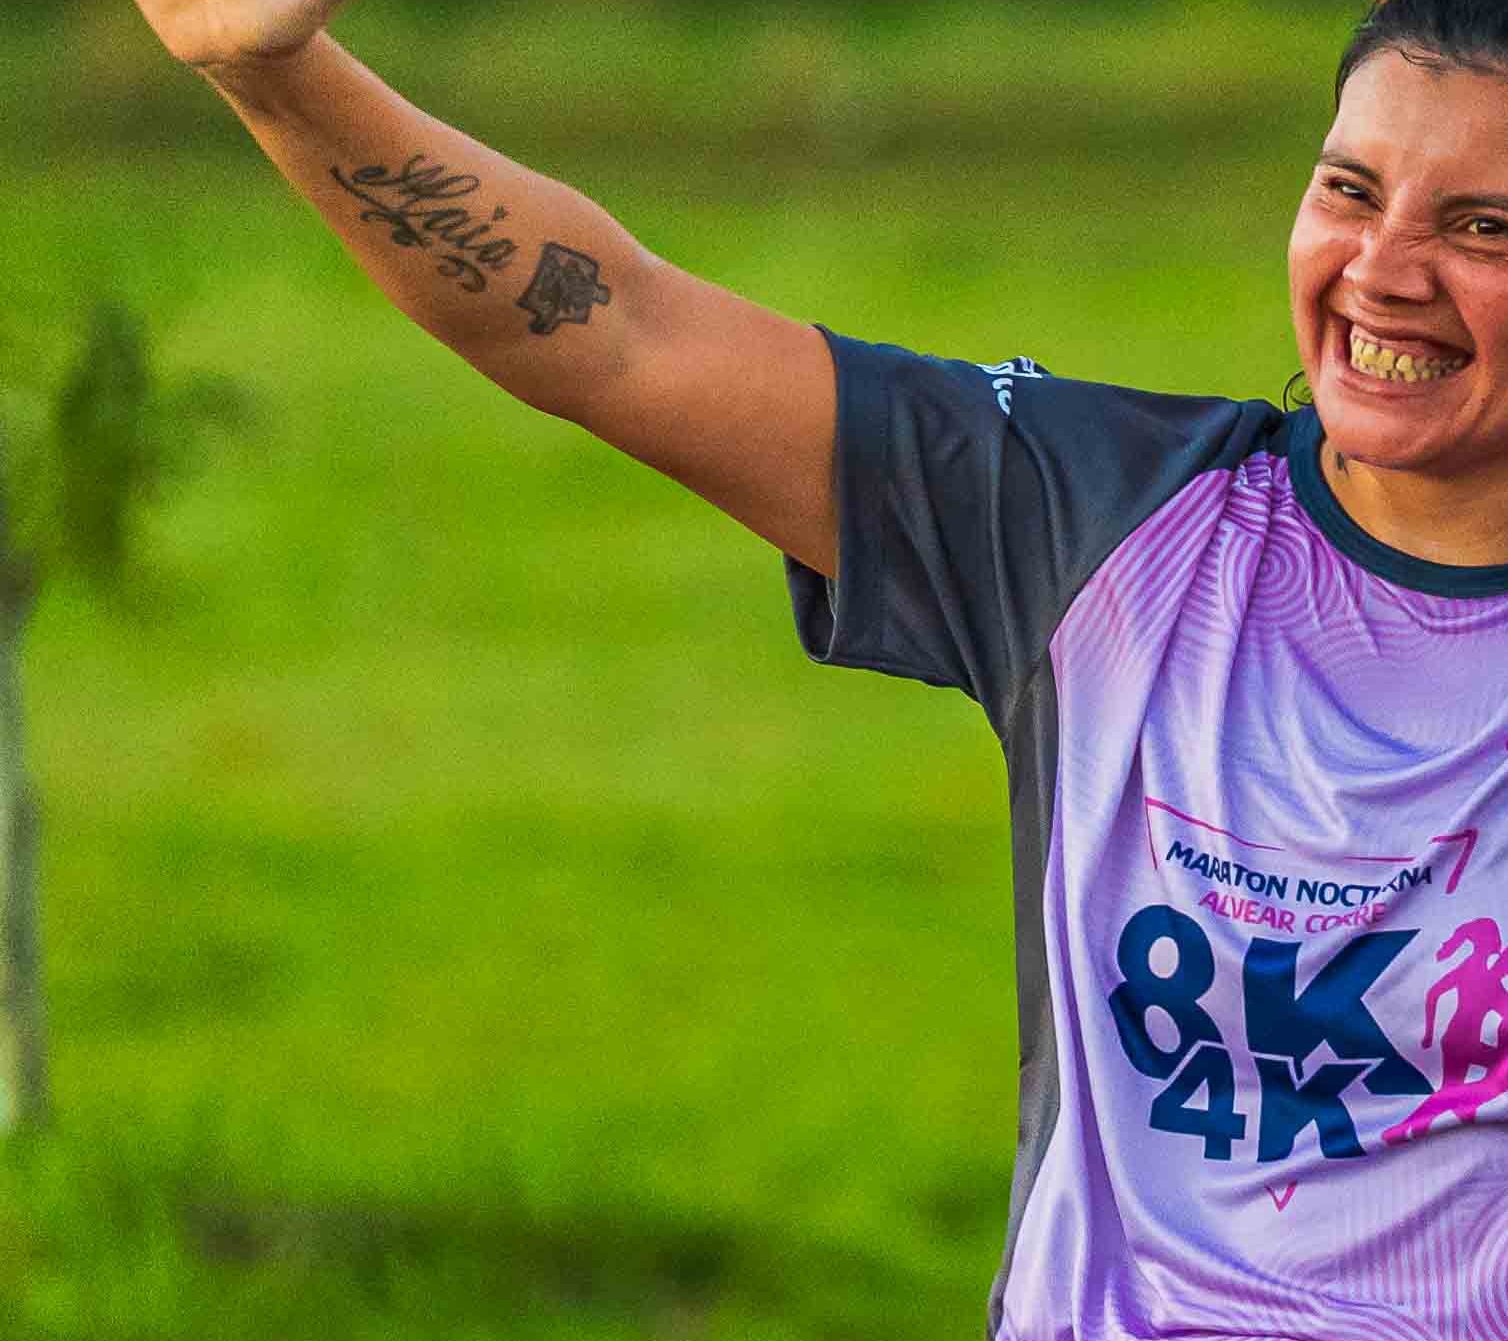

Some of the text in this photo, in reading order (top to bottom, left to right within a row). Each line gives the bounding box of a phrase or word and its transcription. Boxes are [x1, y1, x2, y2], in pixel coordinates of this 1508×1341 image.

[1165, 840, 1289, 899] MARATON
[1198, 890, 1296, 935] ALVEAR
[1108, 904, 1435, 1095] 8K
[1148, 1044, 1368, 1163] 4K
